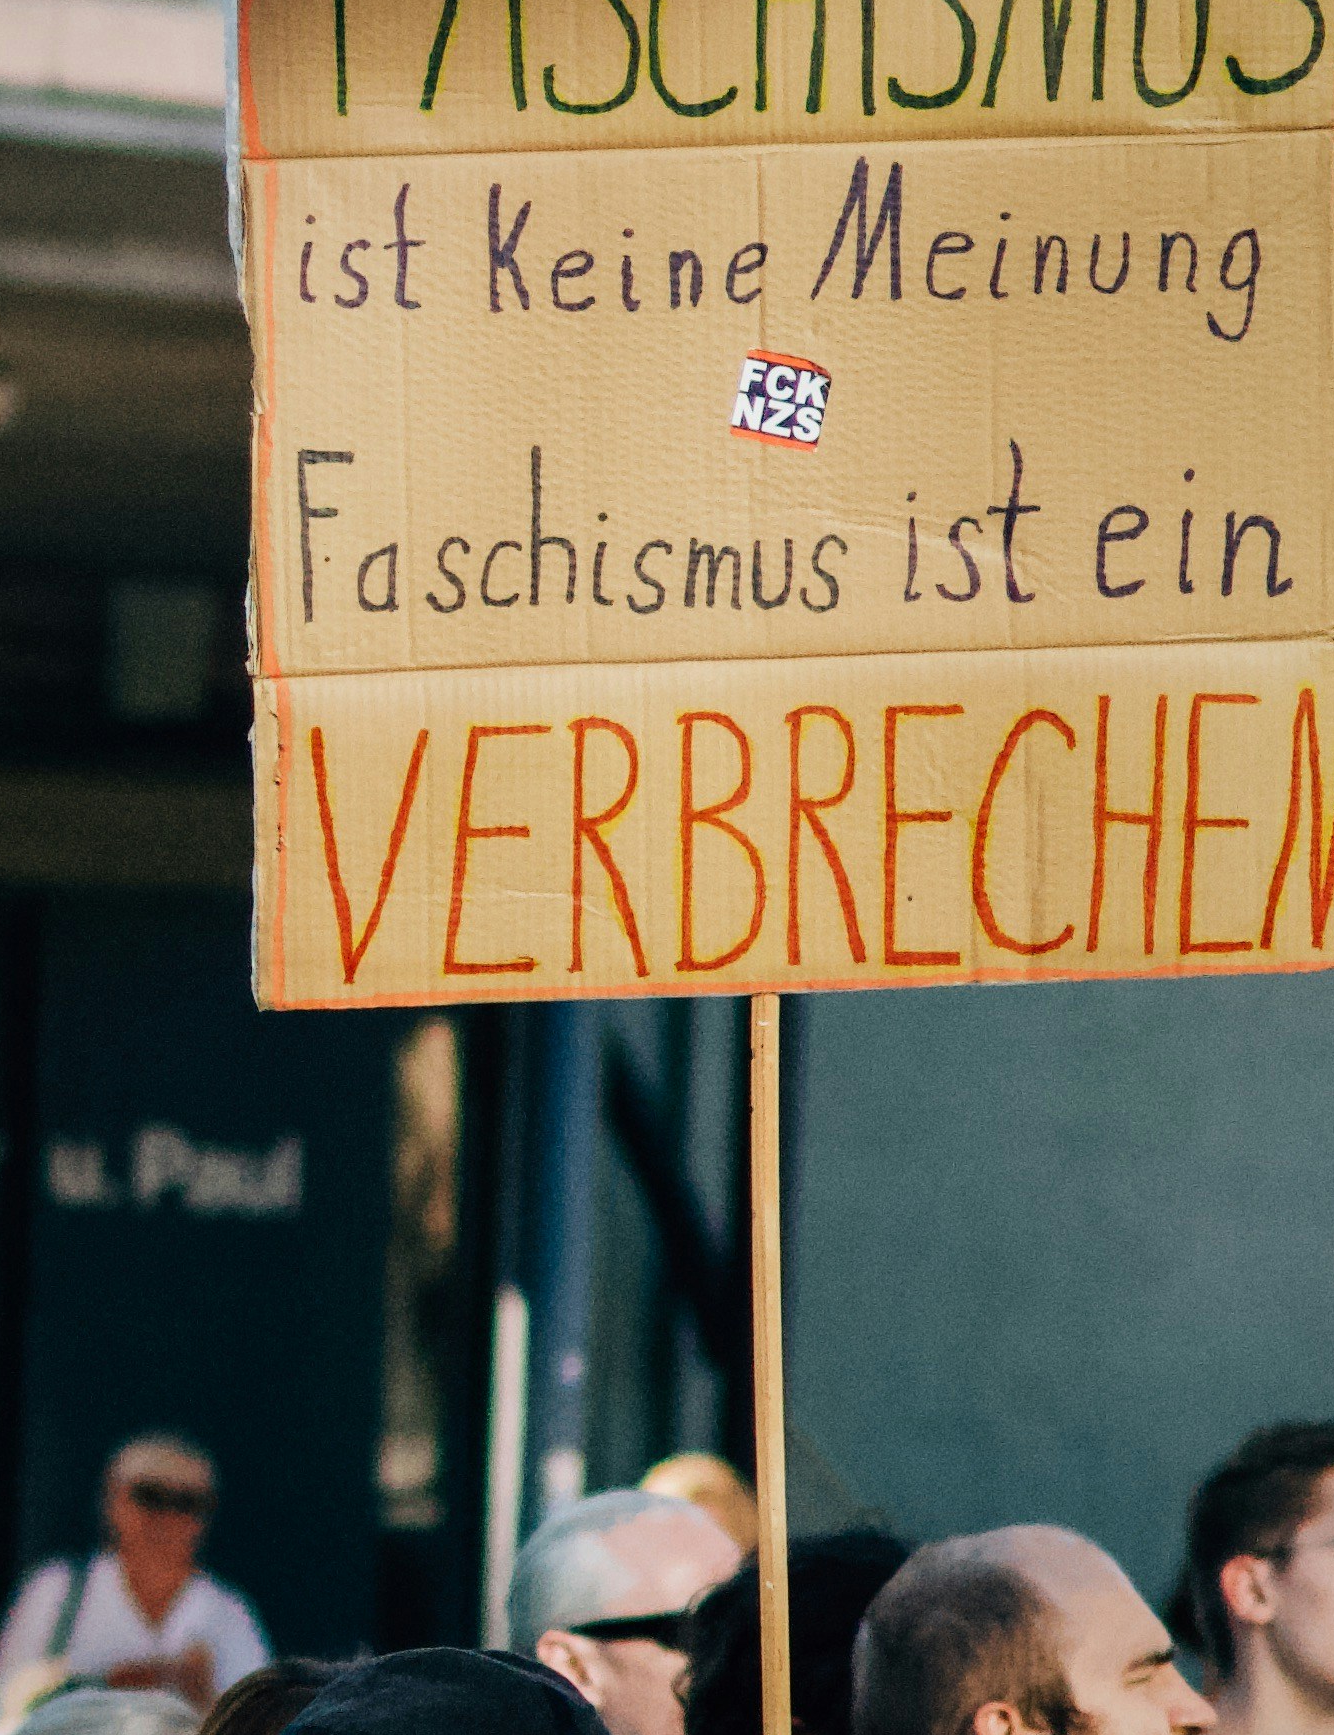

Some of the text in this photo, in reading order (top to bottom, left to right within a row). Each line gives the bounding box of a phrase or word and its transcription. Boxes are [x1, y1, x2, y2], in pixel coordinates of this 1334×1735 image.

[298, 183, 424, 311] ist
[810, 155, 1262, 344] Meinung
[731, 392, 823, 442] NZS
[739, 359, 829, 409] FCK
[296, 439, 1294, 624] Faschismus ist ein
[132, 1124, 304, 1216] Paul
